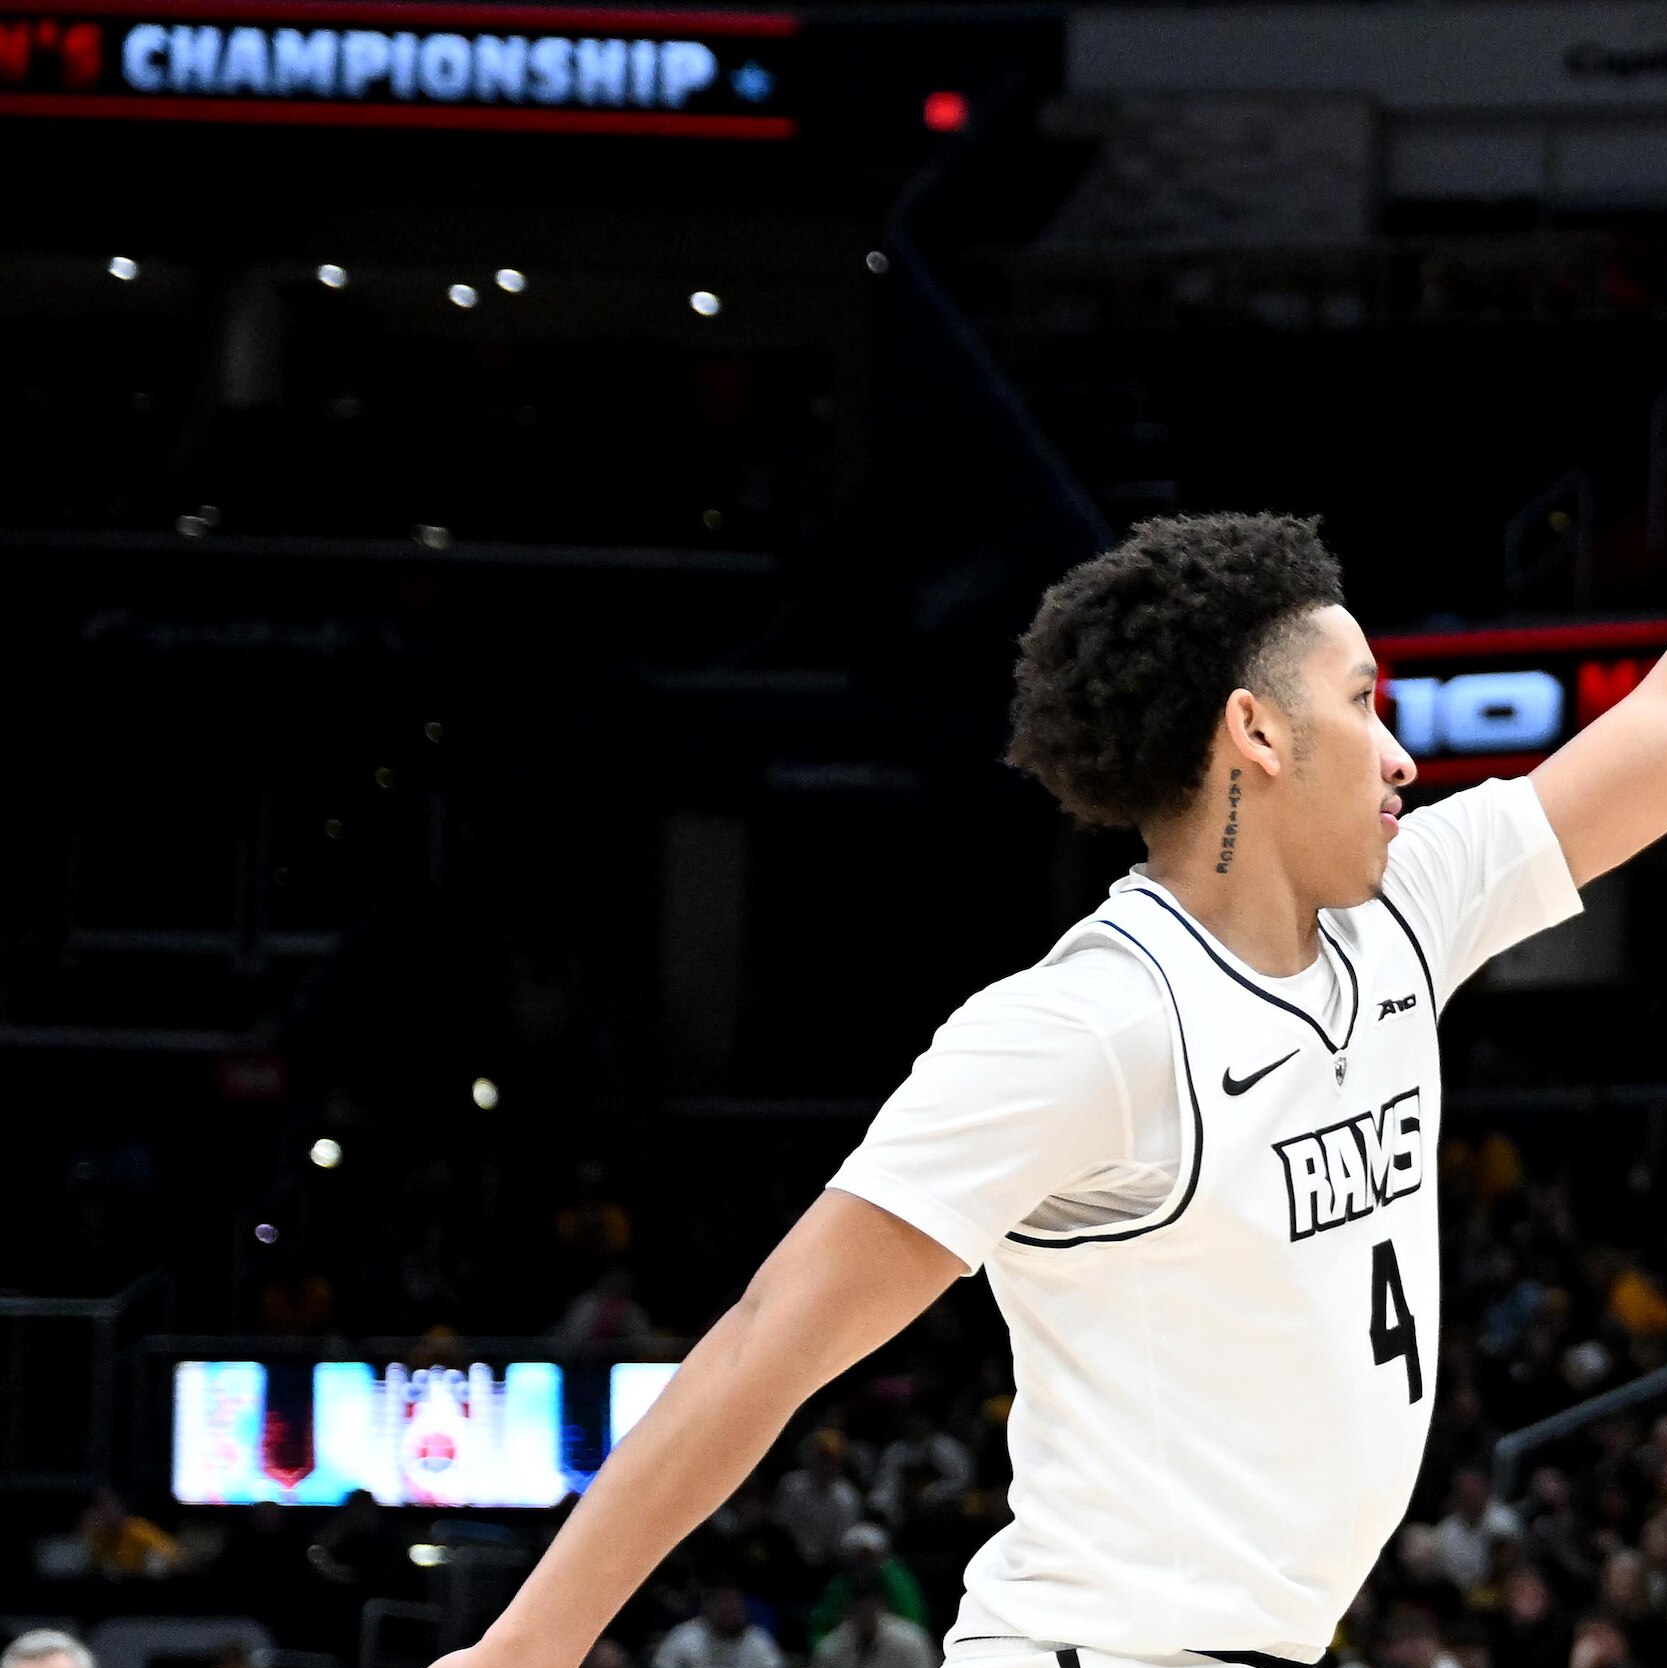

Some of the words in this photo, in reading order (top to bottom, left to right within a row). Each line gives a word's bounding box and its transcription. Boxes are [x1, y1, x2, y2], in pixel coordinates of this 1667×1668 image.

[121, 23, 718, 110] CHAMPIONSHIP
[1376, 670, 1566, 757] 10
[1271, 1086, 1423, 1242] RAMS
[1369, 1238, 1424, 1405] 4
